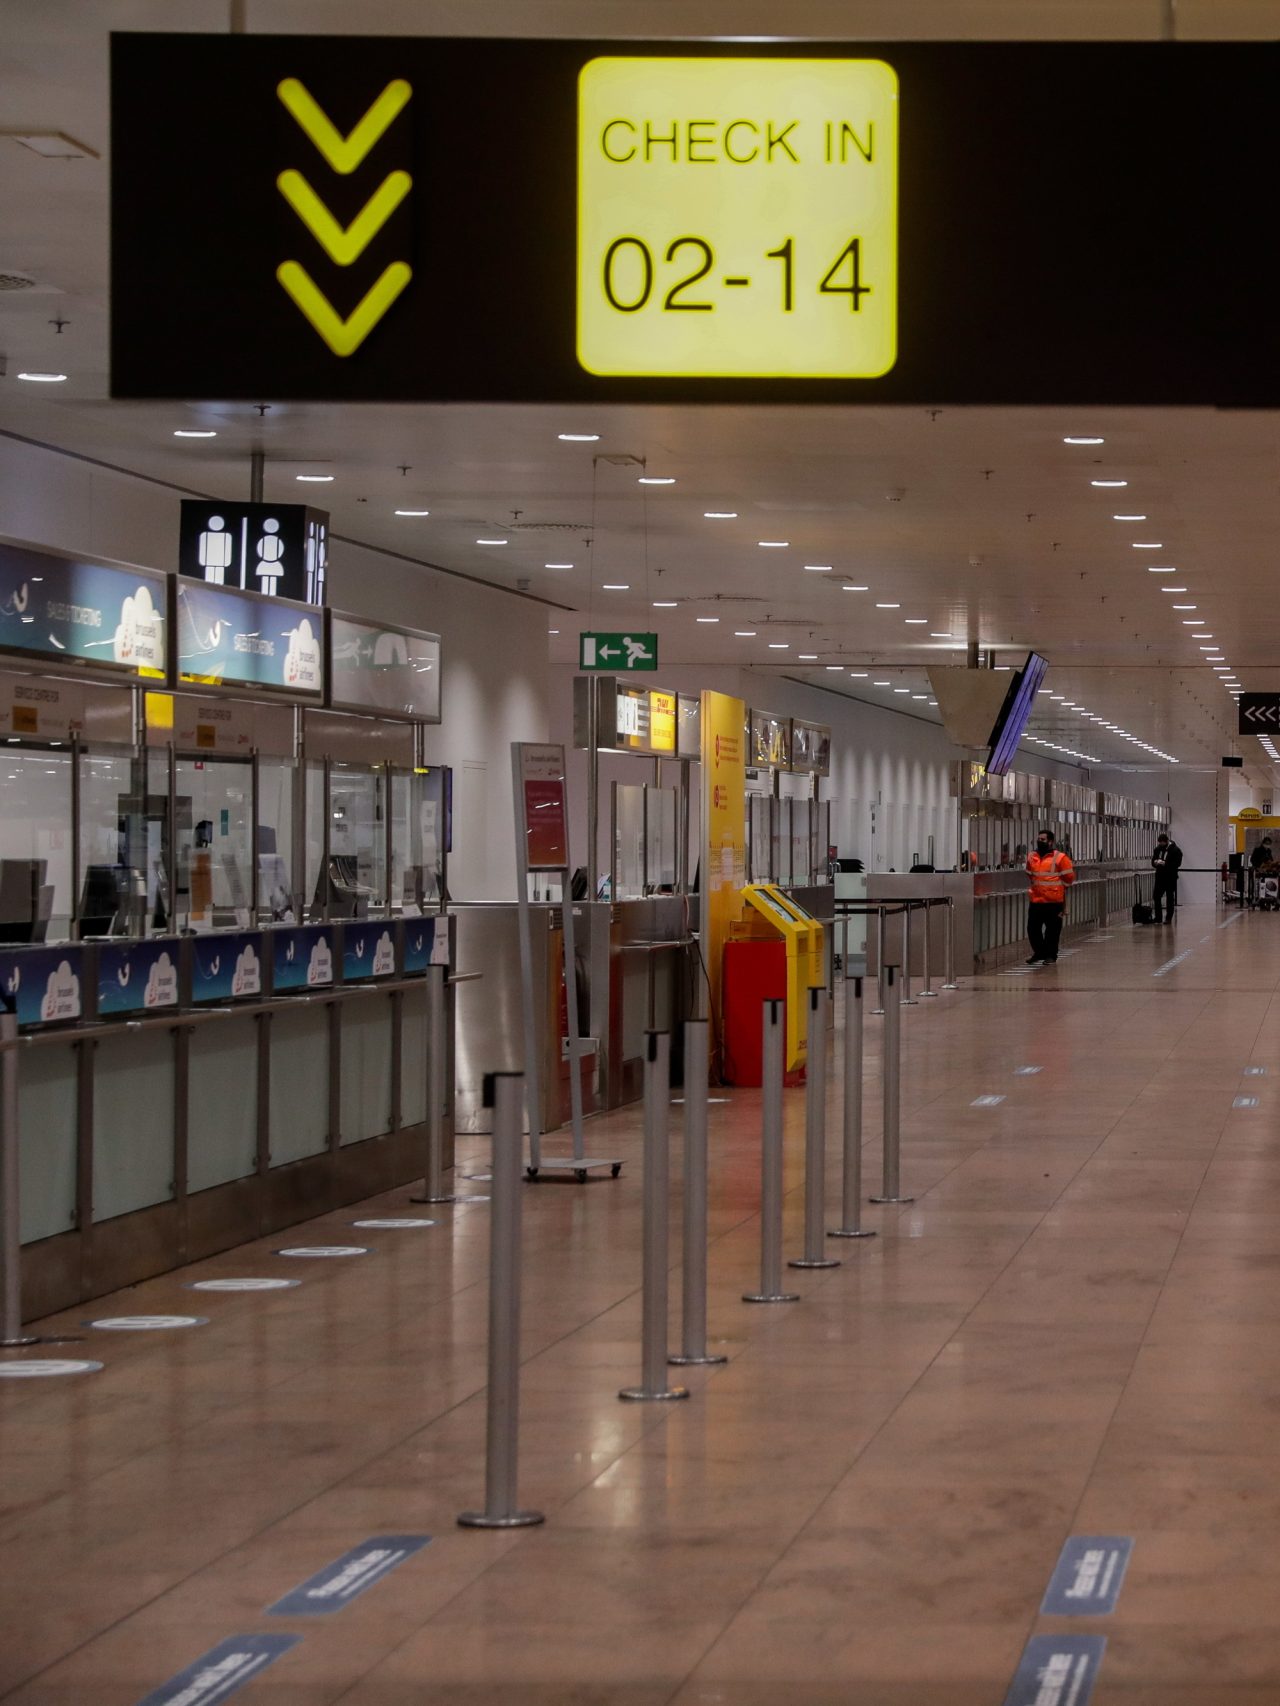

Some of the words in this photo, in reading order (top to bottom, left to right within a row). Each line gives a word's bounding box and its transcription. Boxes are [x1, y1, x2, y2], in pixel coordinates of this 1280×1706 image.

[601, 119, 799, 163] CHECK
[825, 121, 873, 163] IN
[602, 236, 872, 313] 02-14
